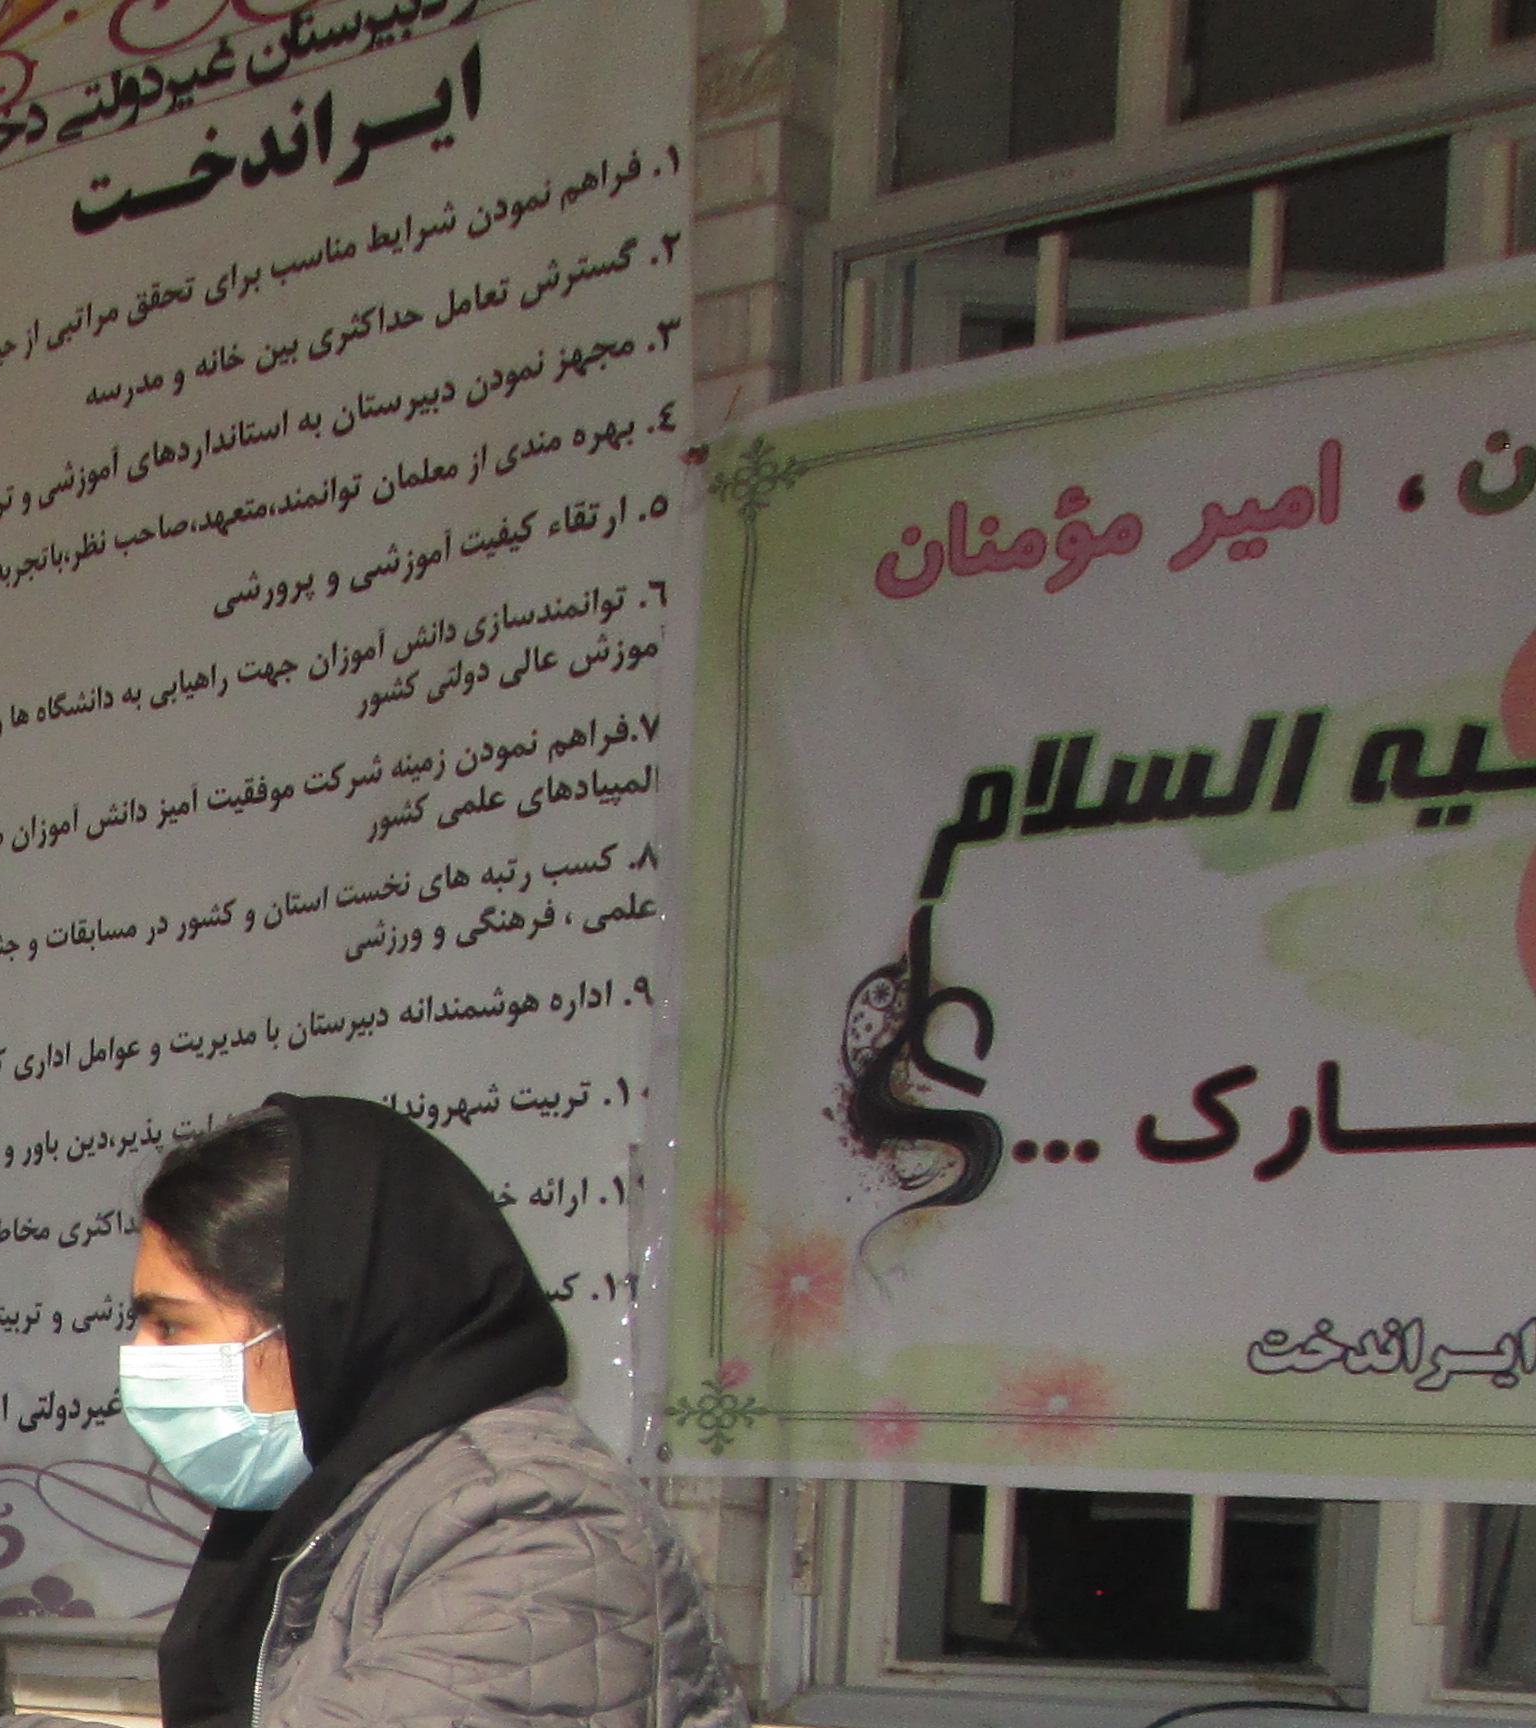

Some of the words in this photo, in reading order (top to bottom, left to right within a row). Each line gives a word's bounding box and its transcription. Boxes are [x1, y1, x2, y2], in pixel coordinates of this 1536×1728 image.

[72, 42, 482, 235] ایراندخت
[560, 149, 642, 212] فراهم
[366, 200, 457, 255] شرایط
[466, 179, 552, 240] نمودن
[204, 262, 262, 307] برای
[434, 277, 510, 330] تعامل
[172, 368, 186, 397] و
[465, 349, 545, 409] نمودن
[331, 380, 457, 438] دبیرستان
[21, 490, 32, 517] و
[371, 456, 459, 506] معلمان
[1169, 438, 1344, 573] امیر
[326, 570, 341, 599] و
[454, 728, 538, 778] نمودن
[436, 784, 506, 831] علمی
[918, 708, 1325, 902] السلام
[244, 908, 256, 934] و
[432, 924, 447, 952] و
[148, 1041, 161, 1068] و
[509, 1080, 592, 1120] تربیت
[4, 1144, 15, 1169] و
[57, 1208, 141, 1250] داکثری
[51, 1310, 63, 1335] و
